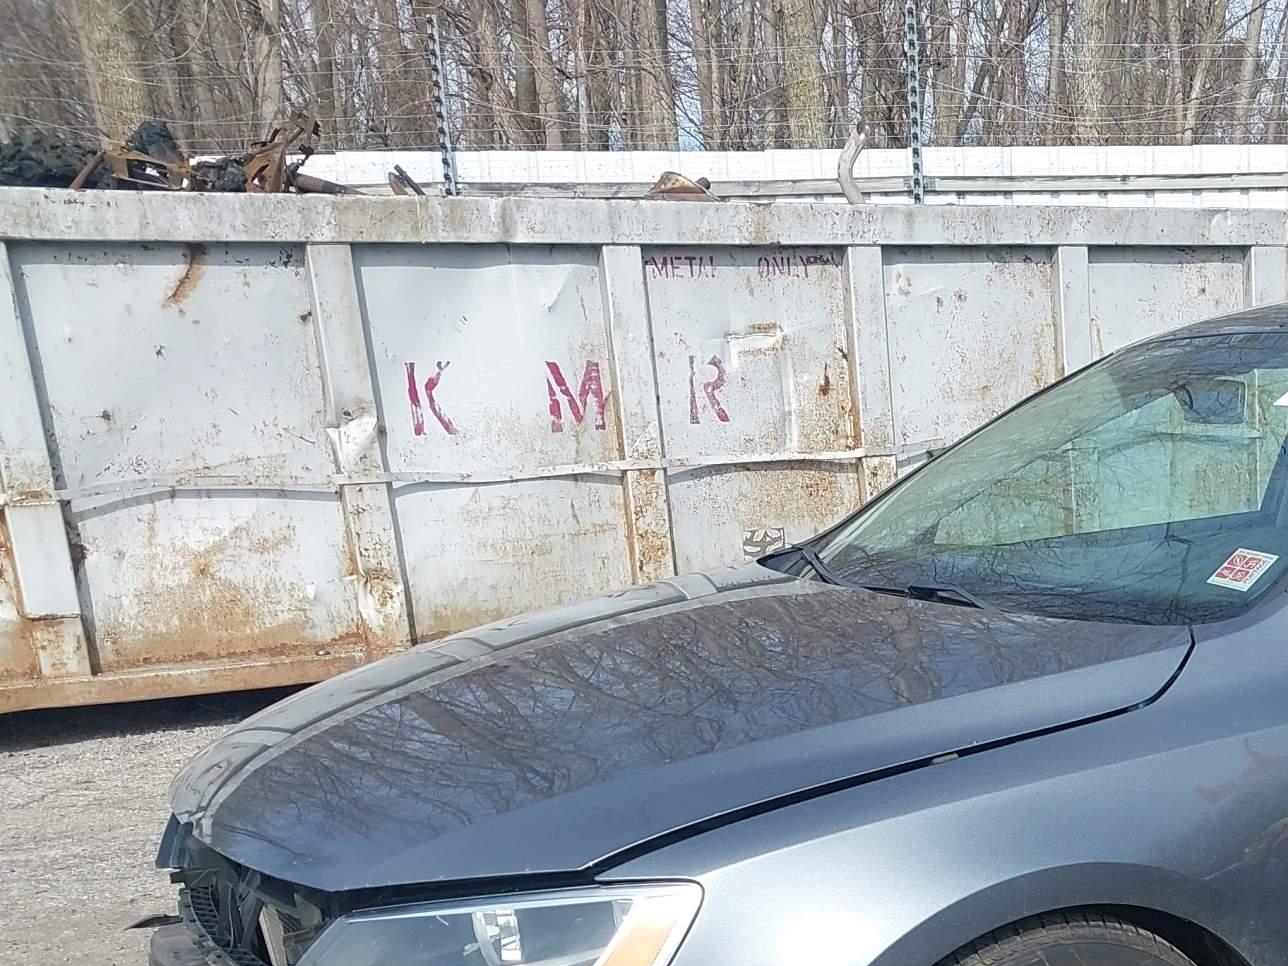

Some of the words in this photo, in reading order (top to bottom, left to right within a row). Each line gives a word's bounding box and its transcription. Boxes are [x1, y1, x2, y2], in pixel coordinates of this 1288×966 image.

[757, 256, 808, 278] ONLY
[404, 361, 459, 436] K
[545, 359, 608, 433] M
[688, 354, 732, 425] R
